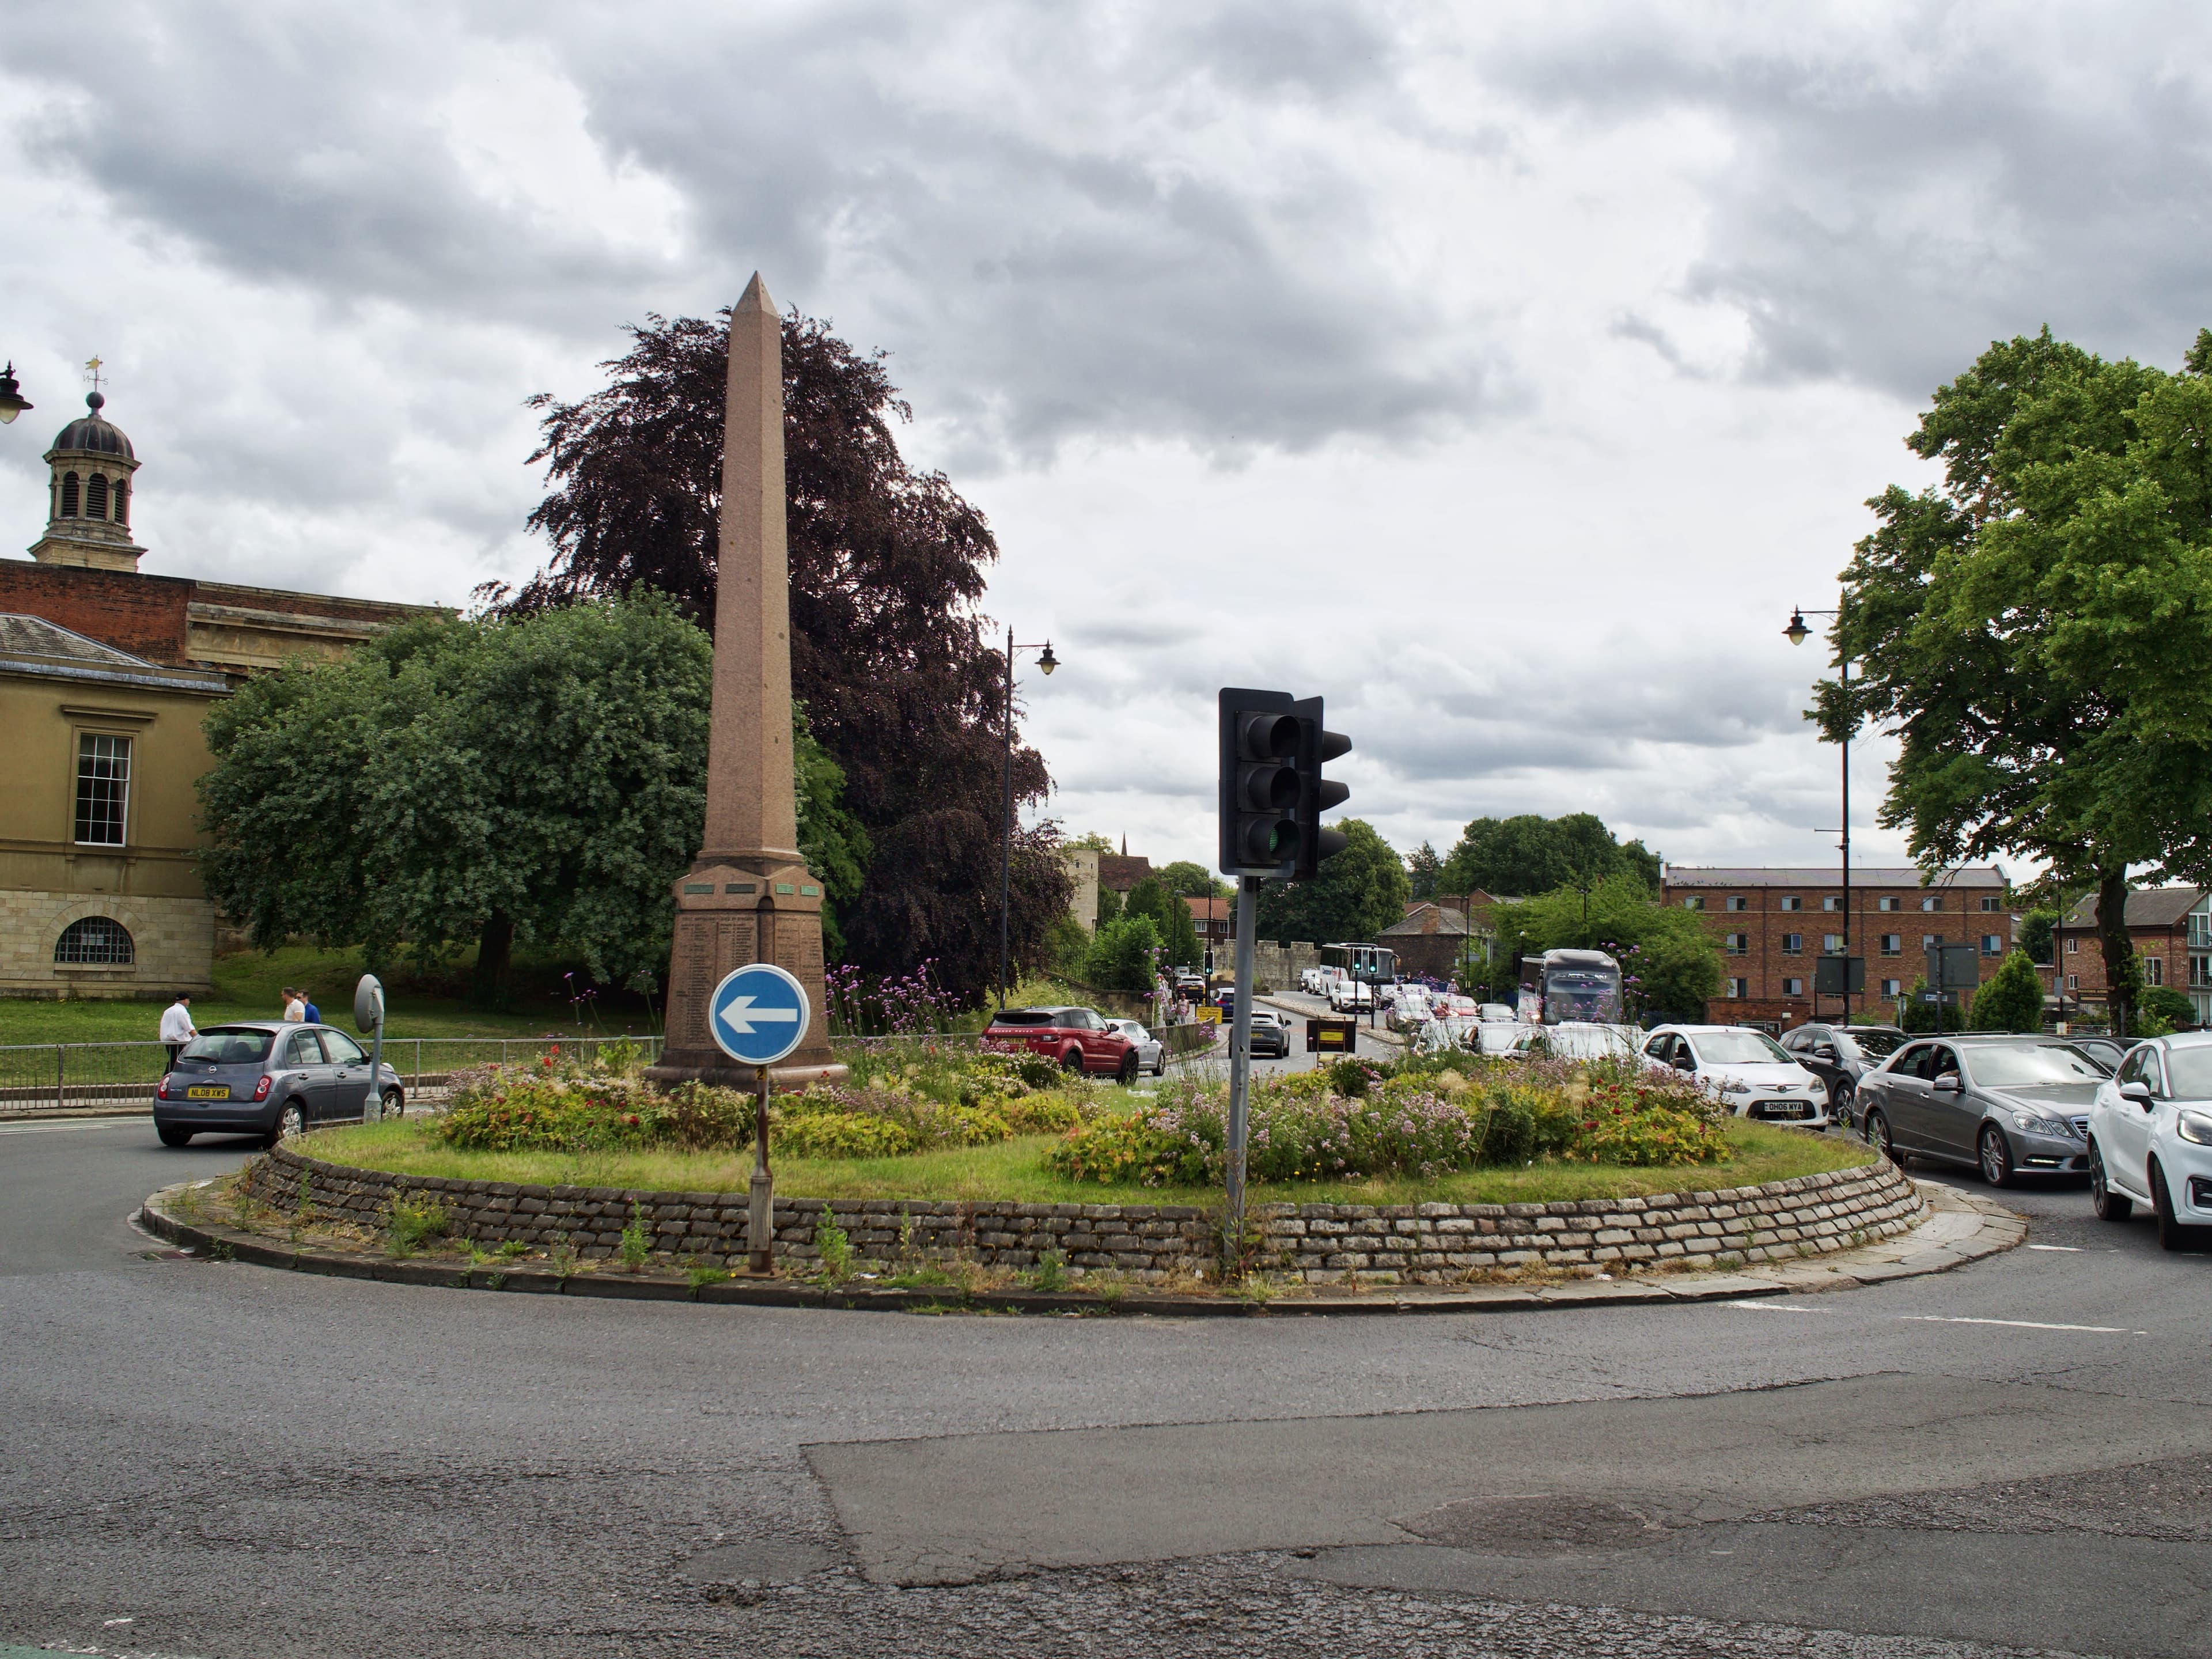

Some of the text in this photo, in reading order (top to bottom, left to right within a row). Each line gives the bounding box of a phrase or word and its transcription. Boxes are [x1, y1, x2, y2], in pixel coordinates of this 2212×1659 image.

[757, 1069, 763, 1080] 2
[191, 1089, 210, 1097] NL08
[211, 1089, 226, 1097] XWS
